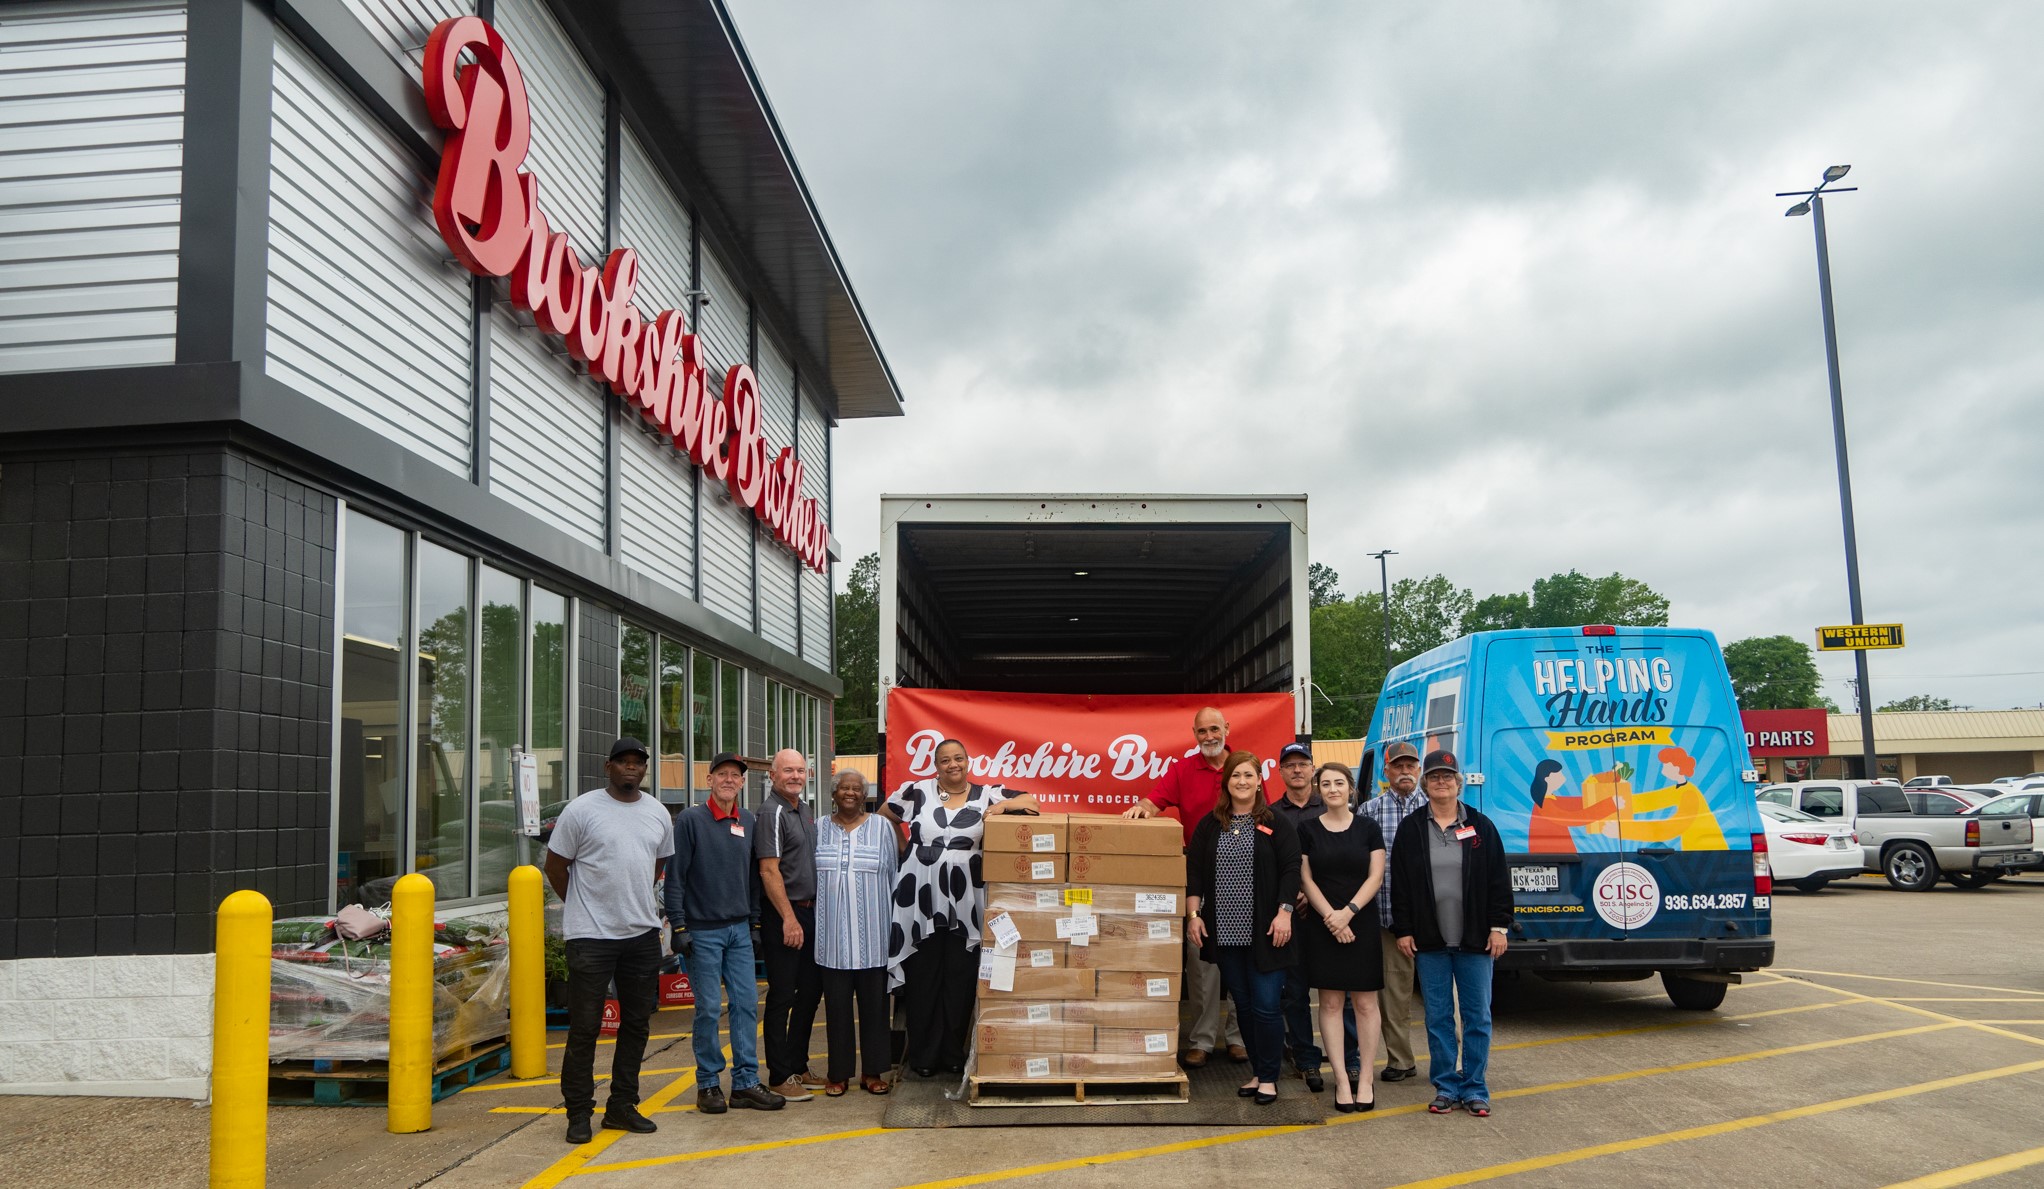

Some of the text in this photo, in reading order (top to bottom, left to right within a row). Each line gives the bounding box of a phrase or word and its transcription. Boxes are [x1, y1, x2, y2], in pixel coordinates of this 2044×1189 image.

[423, 16, 829, 574] Brookshire Brothers
[1824, 627, 1888, 638] WESTERN
[1585, 645, 1615, 654] THE
[1845, 636, 1889, 647] UNION
[1533, 657, 1674, 696] HELPING
[1545, 688, 1668, 728] Hands
[1382, 702, 1414, 739] HELPING
[1565, 730, 1656, 747] PROGRAM
[1760, 730, 1814, 747] PARTS
[906, 729, 1101, 779] Bokshire
[1599, 884, 1654, 900] CISC
[1664, 893, 1747, 910] 936.634.2857
